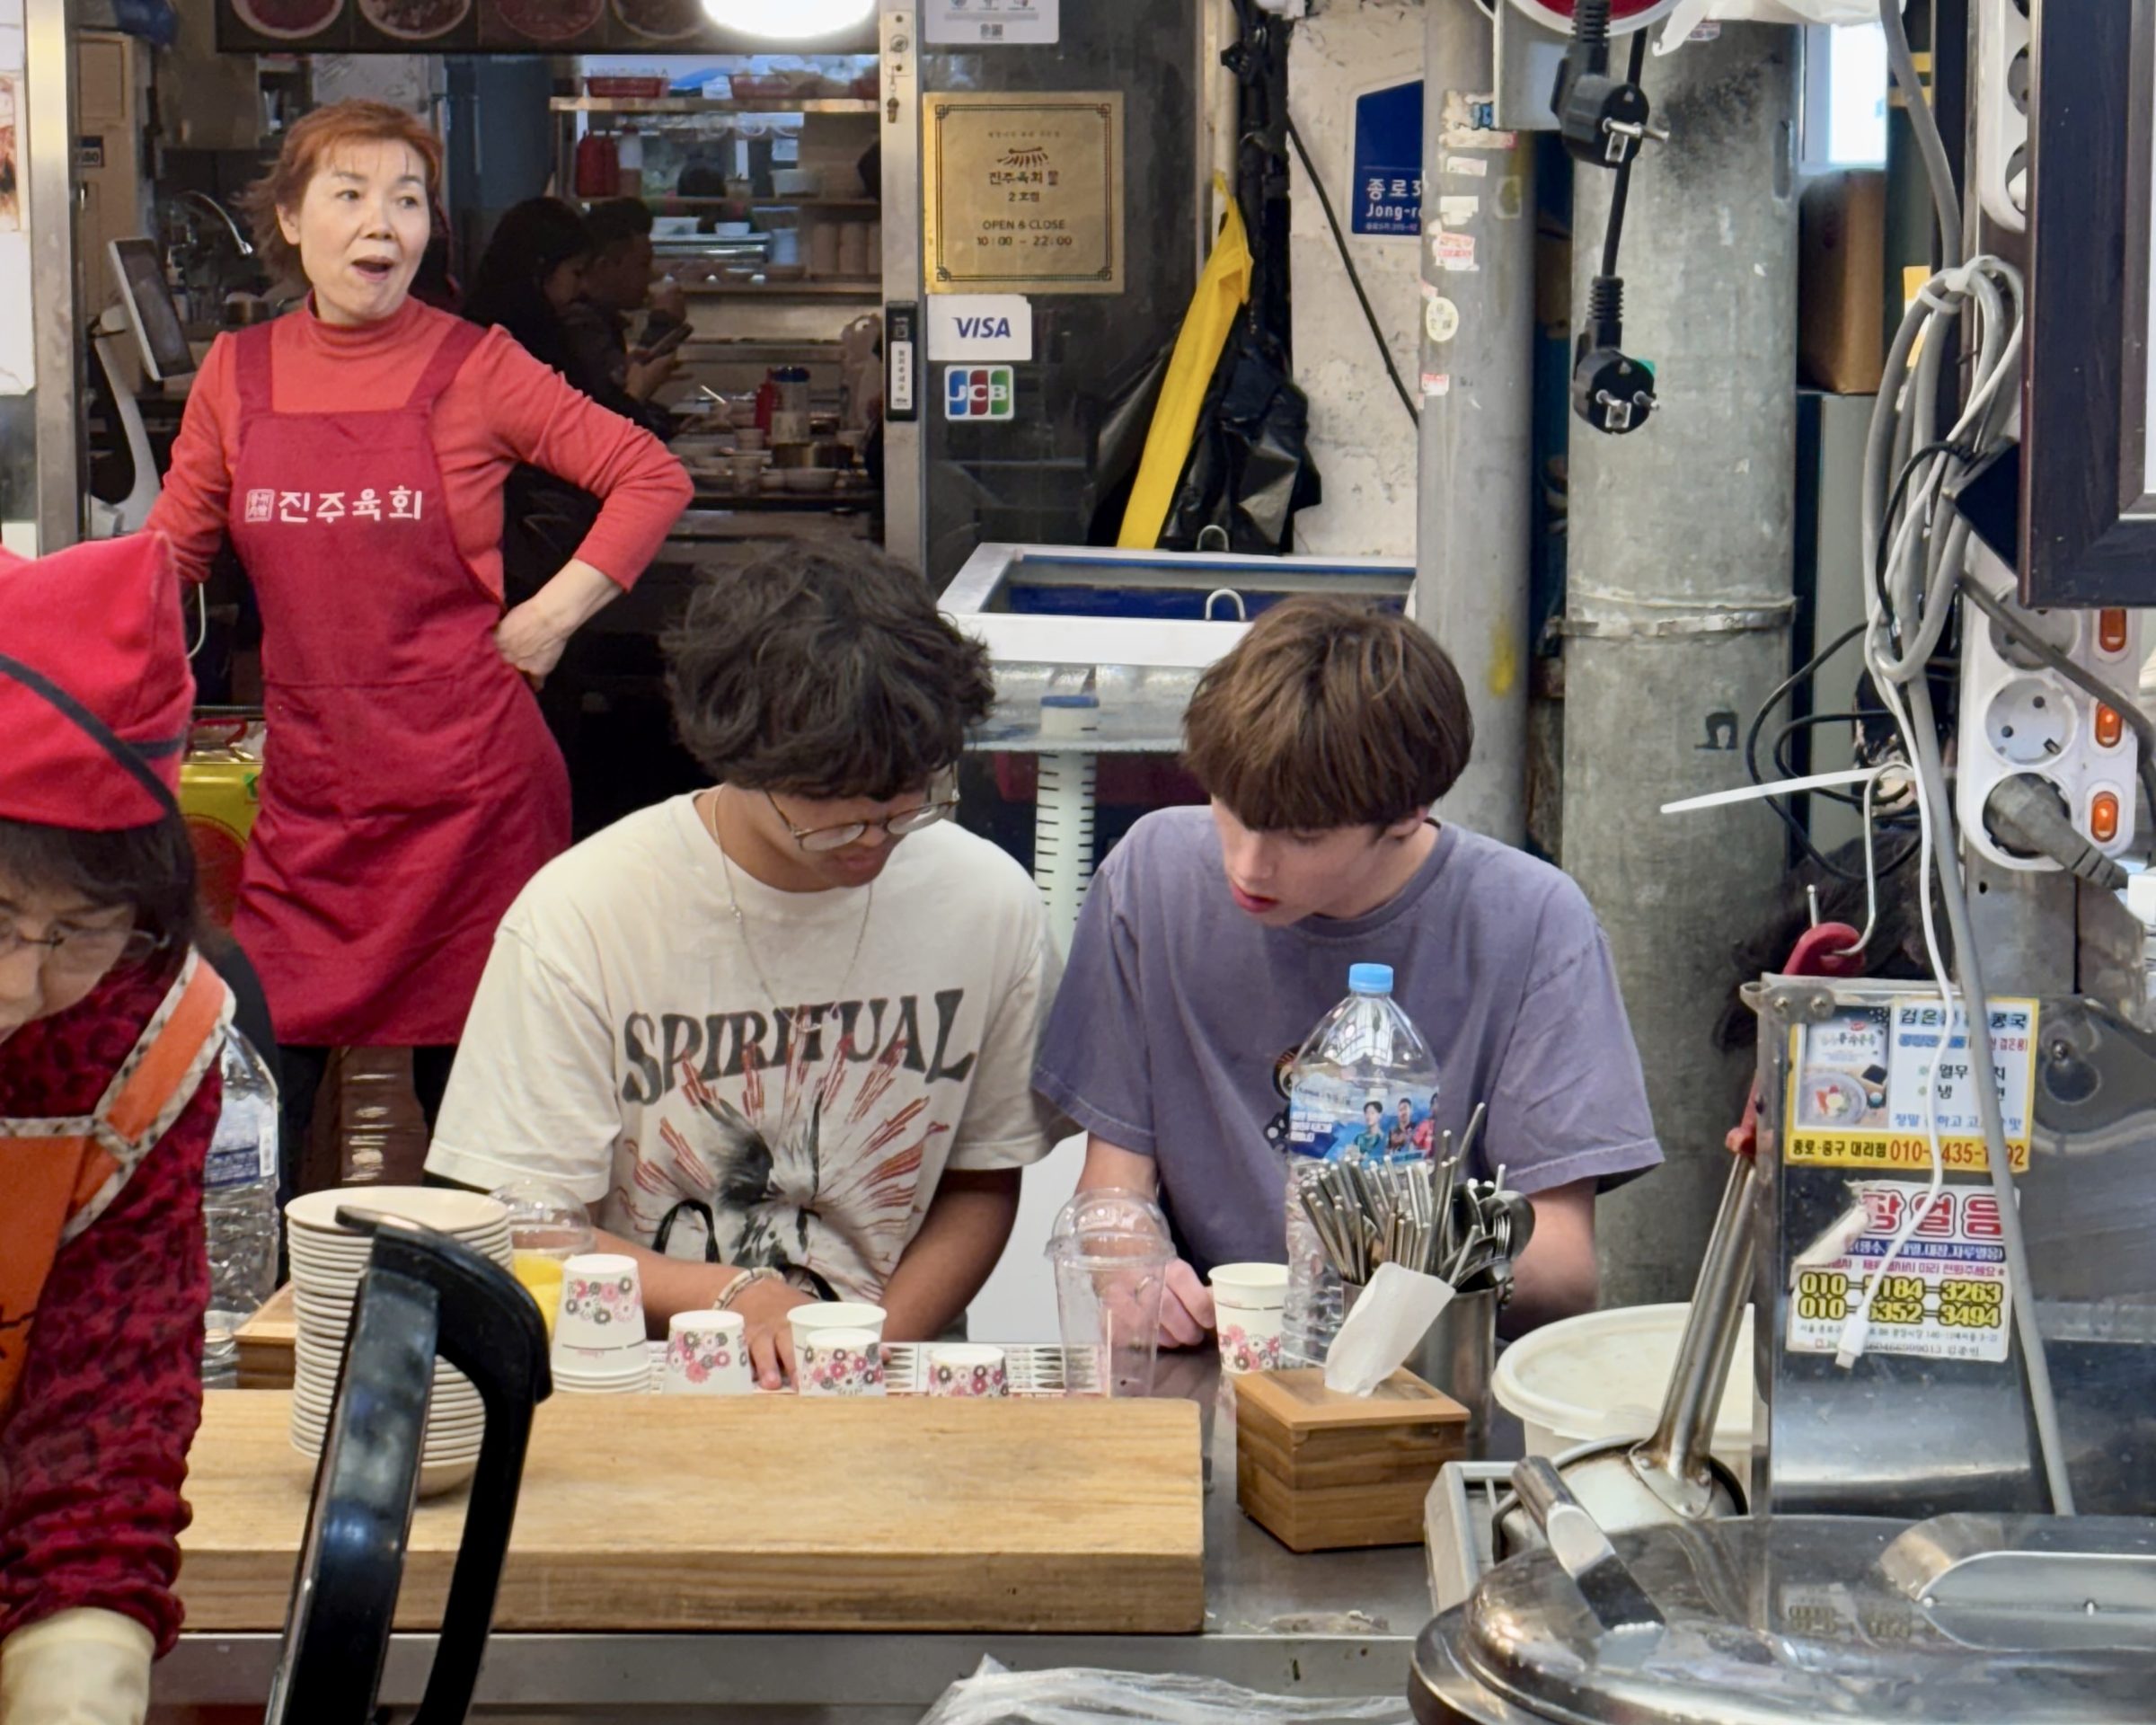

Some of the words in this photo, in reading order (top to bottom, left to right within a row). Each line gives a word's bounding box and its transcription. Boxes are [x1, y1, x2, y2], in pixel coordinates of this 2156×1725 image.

[983, 220, 1015, 230] OPEN
[1018, 220, 1026, 230] &
[1029, 219, 1066, 230] CLOSE
[952, 317, 1012, 338] VISA
[278, 484, 423, 524] 진주육회
[622, 987, 978, 1106] SPIRITUAL
[1851, 1139, 1886, 1158] 대리점
